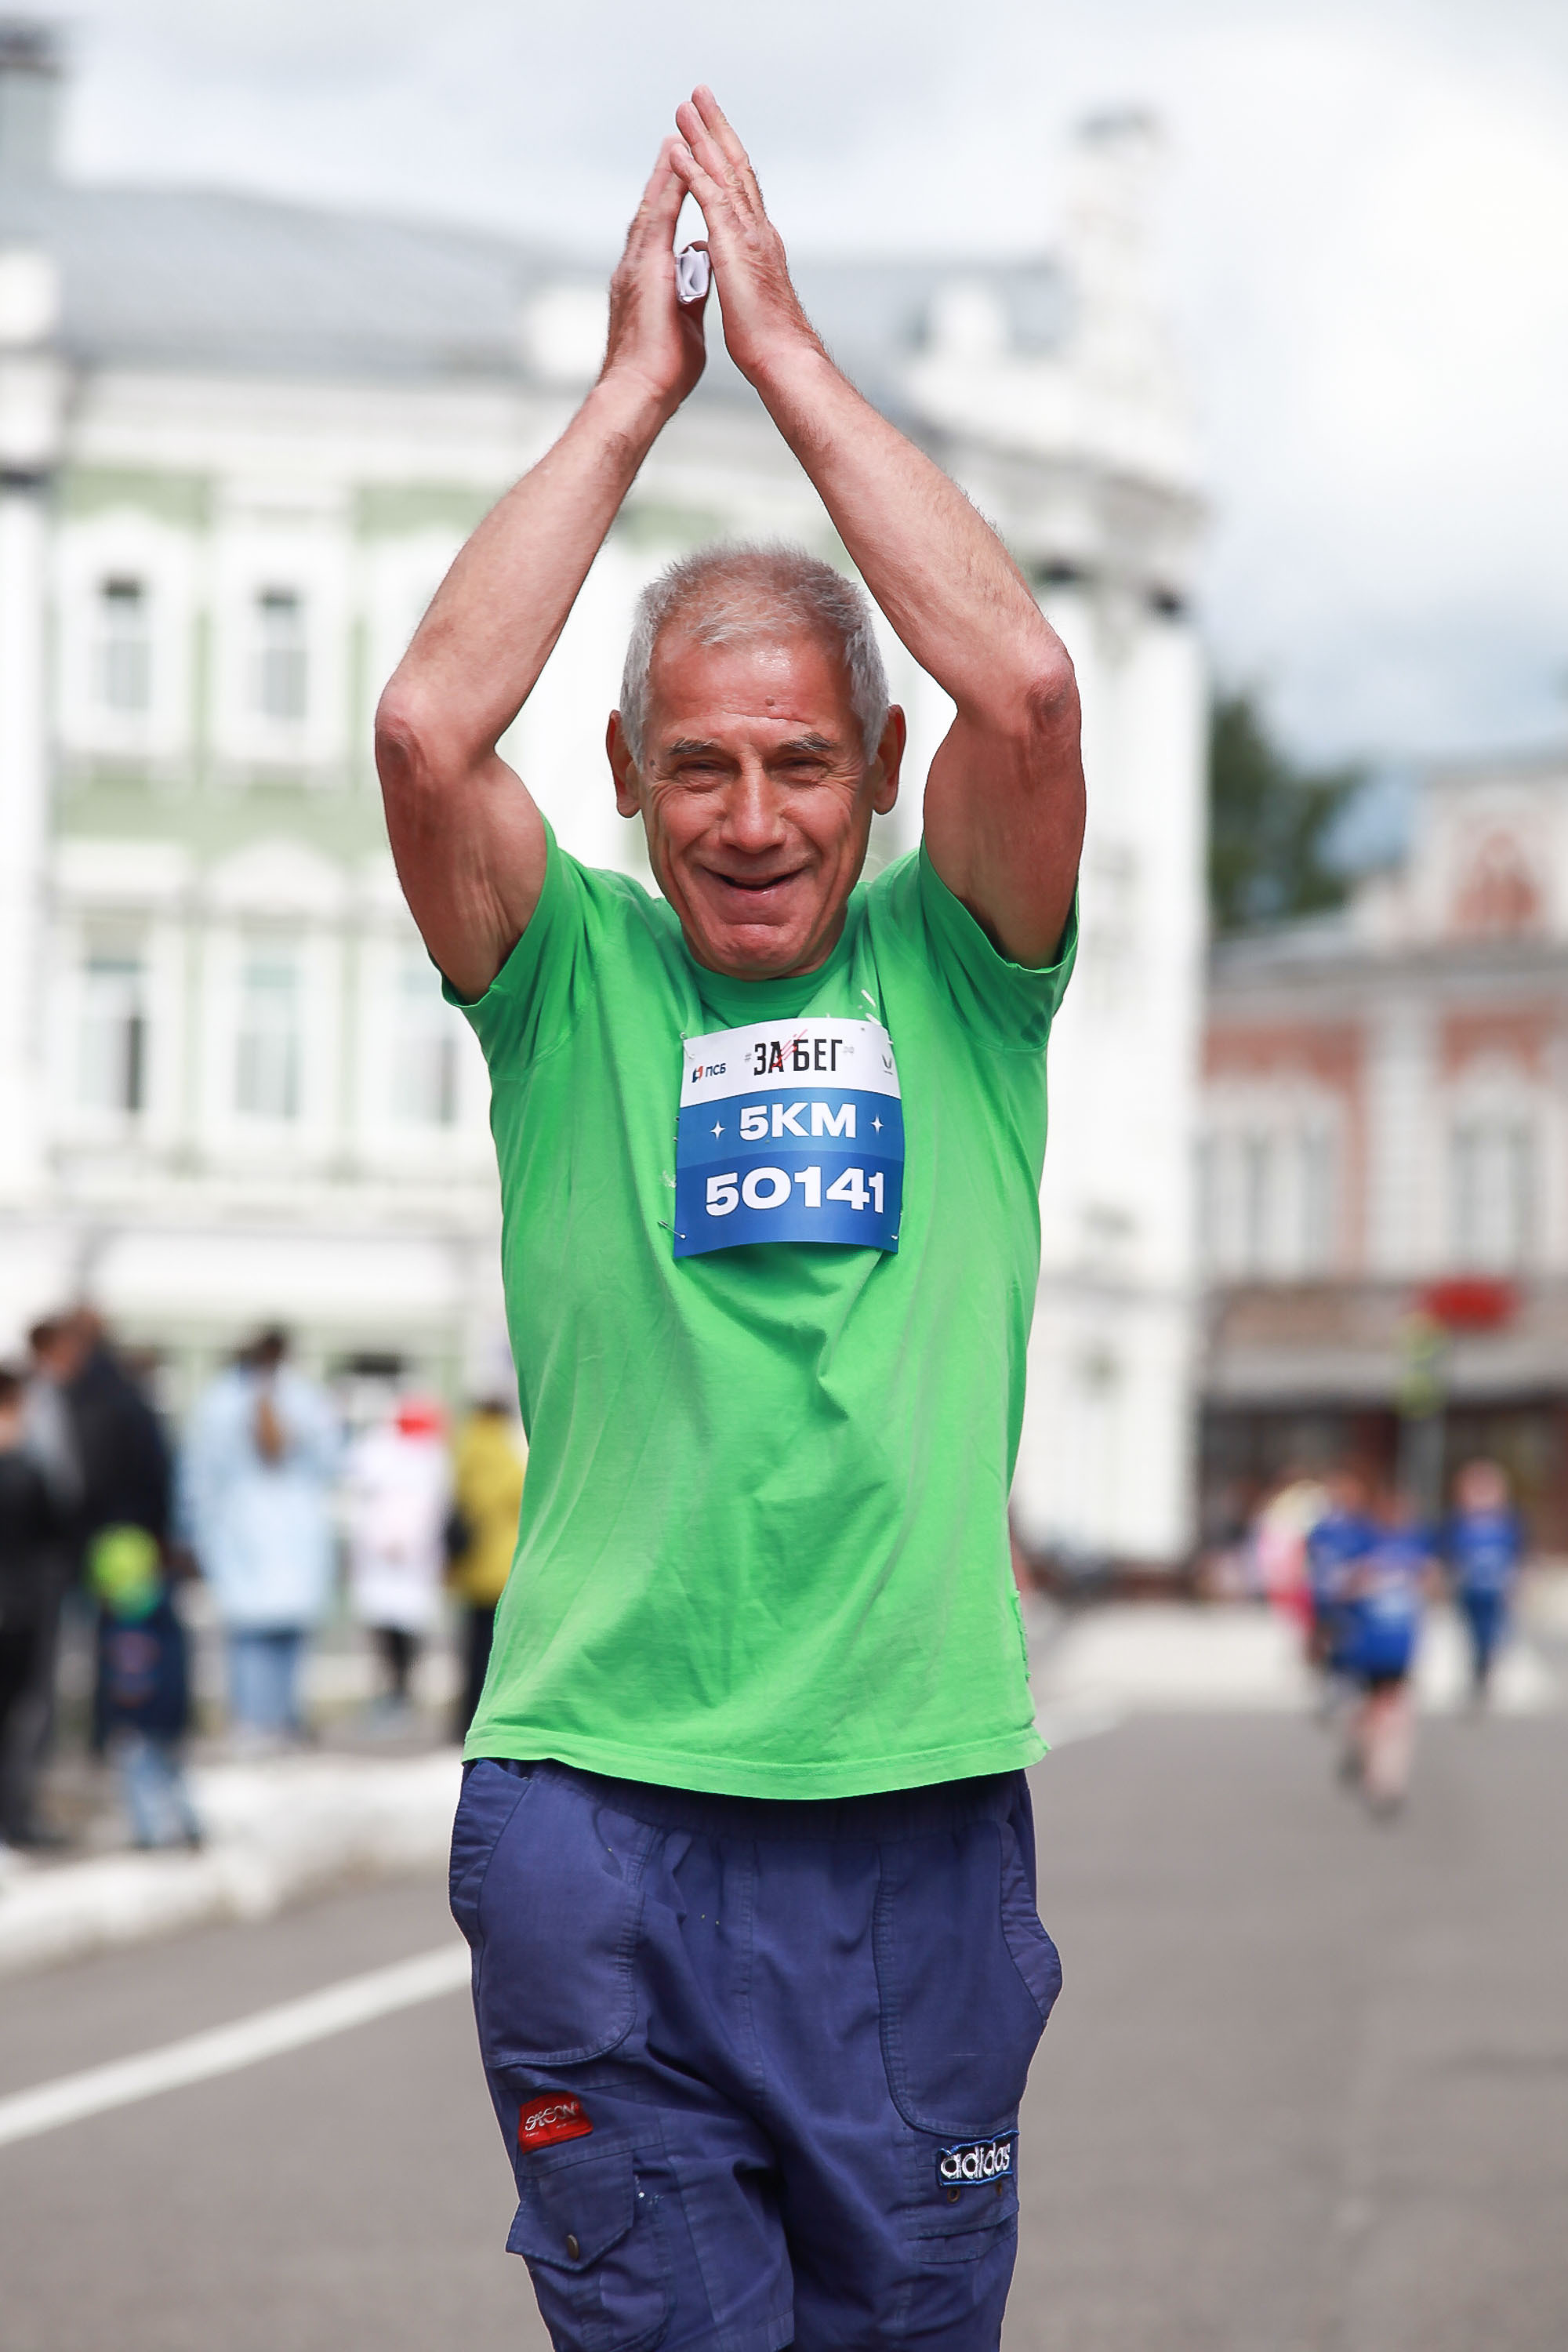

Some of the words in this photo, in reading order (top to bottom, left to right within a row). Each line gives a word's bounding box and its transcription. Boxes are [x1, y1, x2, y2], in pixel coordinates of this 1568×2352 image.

[705, 1062, 727, 1078] ПСБ
[705, 1165, 884, 1217] 50141
[941, 2142, 1011, 2180] adidas
